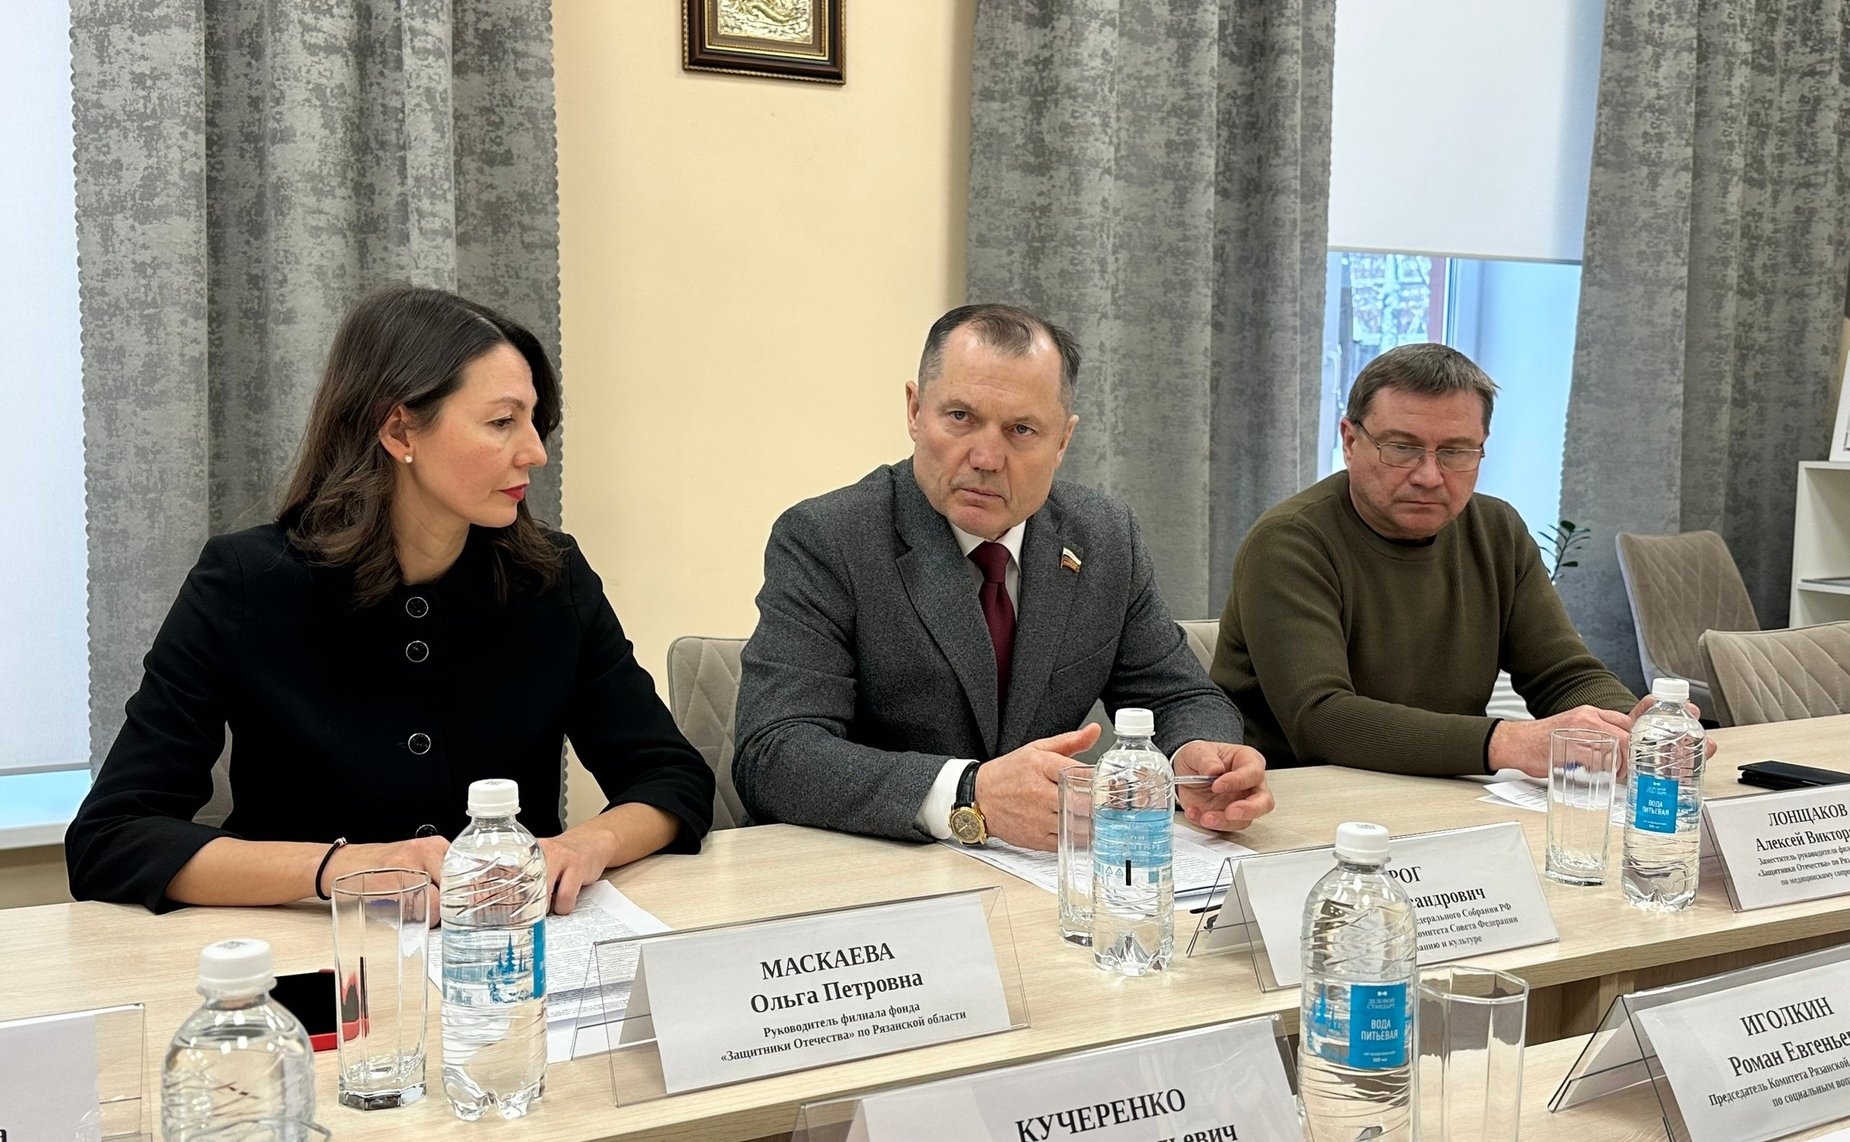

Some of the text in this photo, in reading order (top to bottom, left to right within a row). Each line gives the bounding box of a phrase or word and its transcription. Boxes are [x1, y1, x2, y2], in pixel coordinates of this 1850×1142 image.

[1768, 803, 1848, 826] ЛОНЩАКОВ
[1756, 828, 1850, 852] Алексей Виктор
[1461, 906, 1499, 918] Собрания
[1499, 902, 1512, 912] РФ
[1416, 916, 1519, 938] омитета Совета Федерации
[1416, 935, 1483, 952] анию и культуре
[760, 942, 895, 980] МАСКАЕВА
[750, 972, 924, 1013] Ольга Петровна
[763, 1002, 920, 1038] Руководитель филиала фонда
[1370, 1018, 1392, 1030] ВОДА
[1739, 997, 1835, 1036] ИГОЛКИН
[720, 1010, 967, 1062] «Защитники Отечества» по Рязанской области
[1360, 1029, 1398, 1041] ПИТЬЕВАЯ
[1728, 1050, 1785, 1077] Роман
[1708, 1056, 1850, 1107] Председатель Комитета Рязанской
[1771, 1096, 1784, 1107] по
[1784, 1081, 1836, 1104] социальным
[1015, 1088, 1186, 1142] КУЧЕРЕНКО
